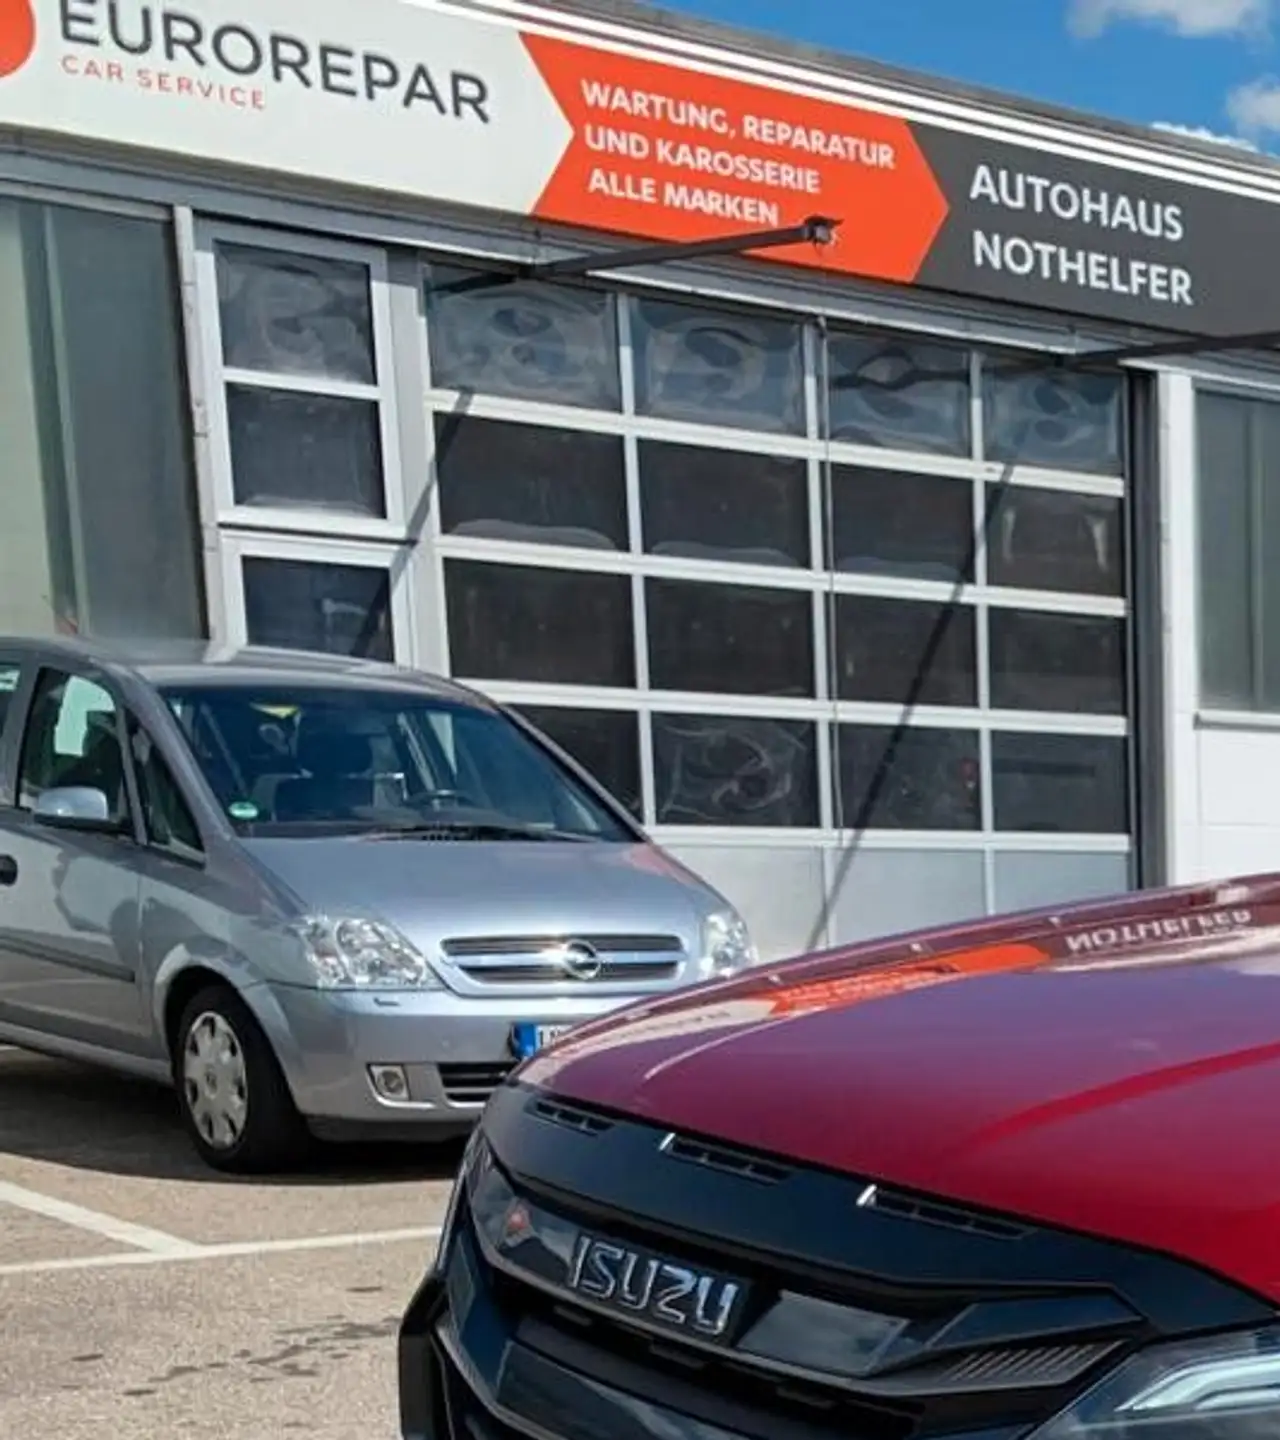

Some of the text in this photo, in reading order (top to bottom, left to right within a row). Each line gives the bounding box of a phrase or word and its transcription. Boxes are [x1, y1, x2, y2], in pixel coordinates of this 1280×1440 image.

[59, 0, 490, 124] EUROREPAR
[61, 54, 266, 110] CAR SERVICE
[581, 78, 895, 169] WARTUNG, REPARATUR
[584, 123, 821, 194] UND KAROSSERIE
[588, 168, 779, 227] ALLE MARKEN
[969, 164, 1184, 242] AUTOHAUS
[972, 229, 1194, 306] NOTHELFER
[570, 1236, 739, 1335] ISUZU
